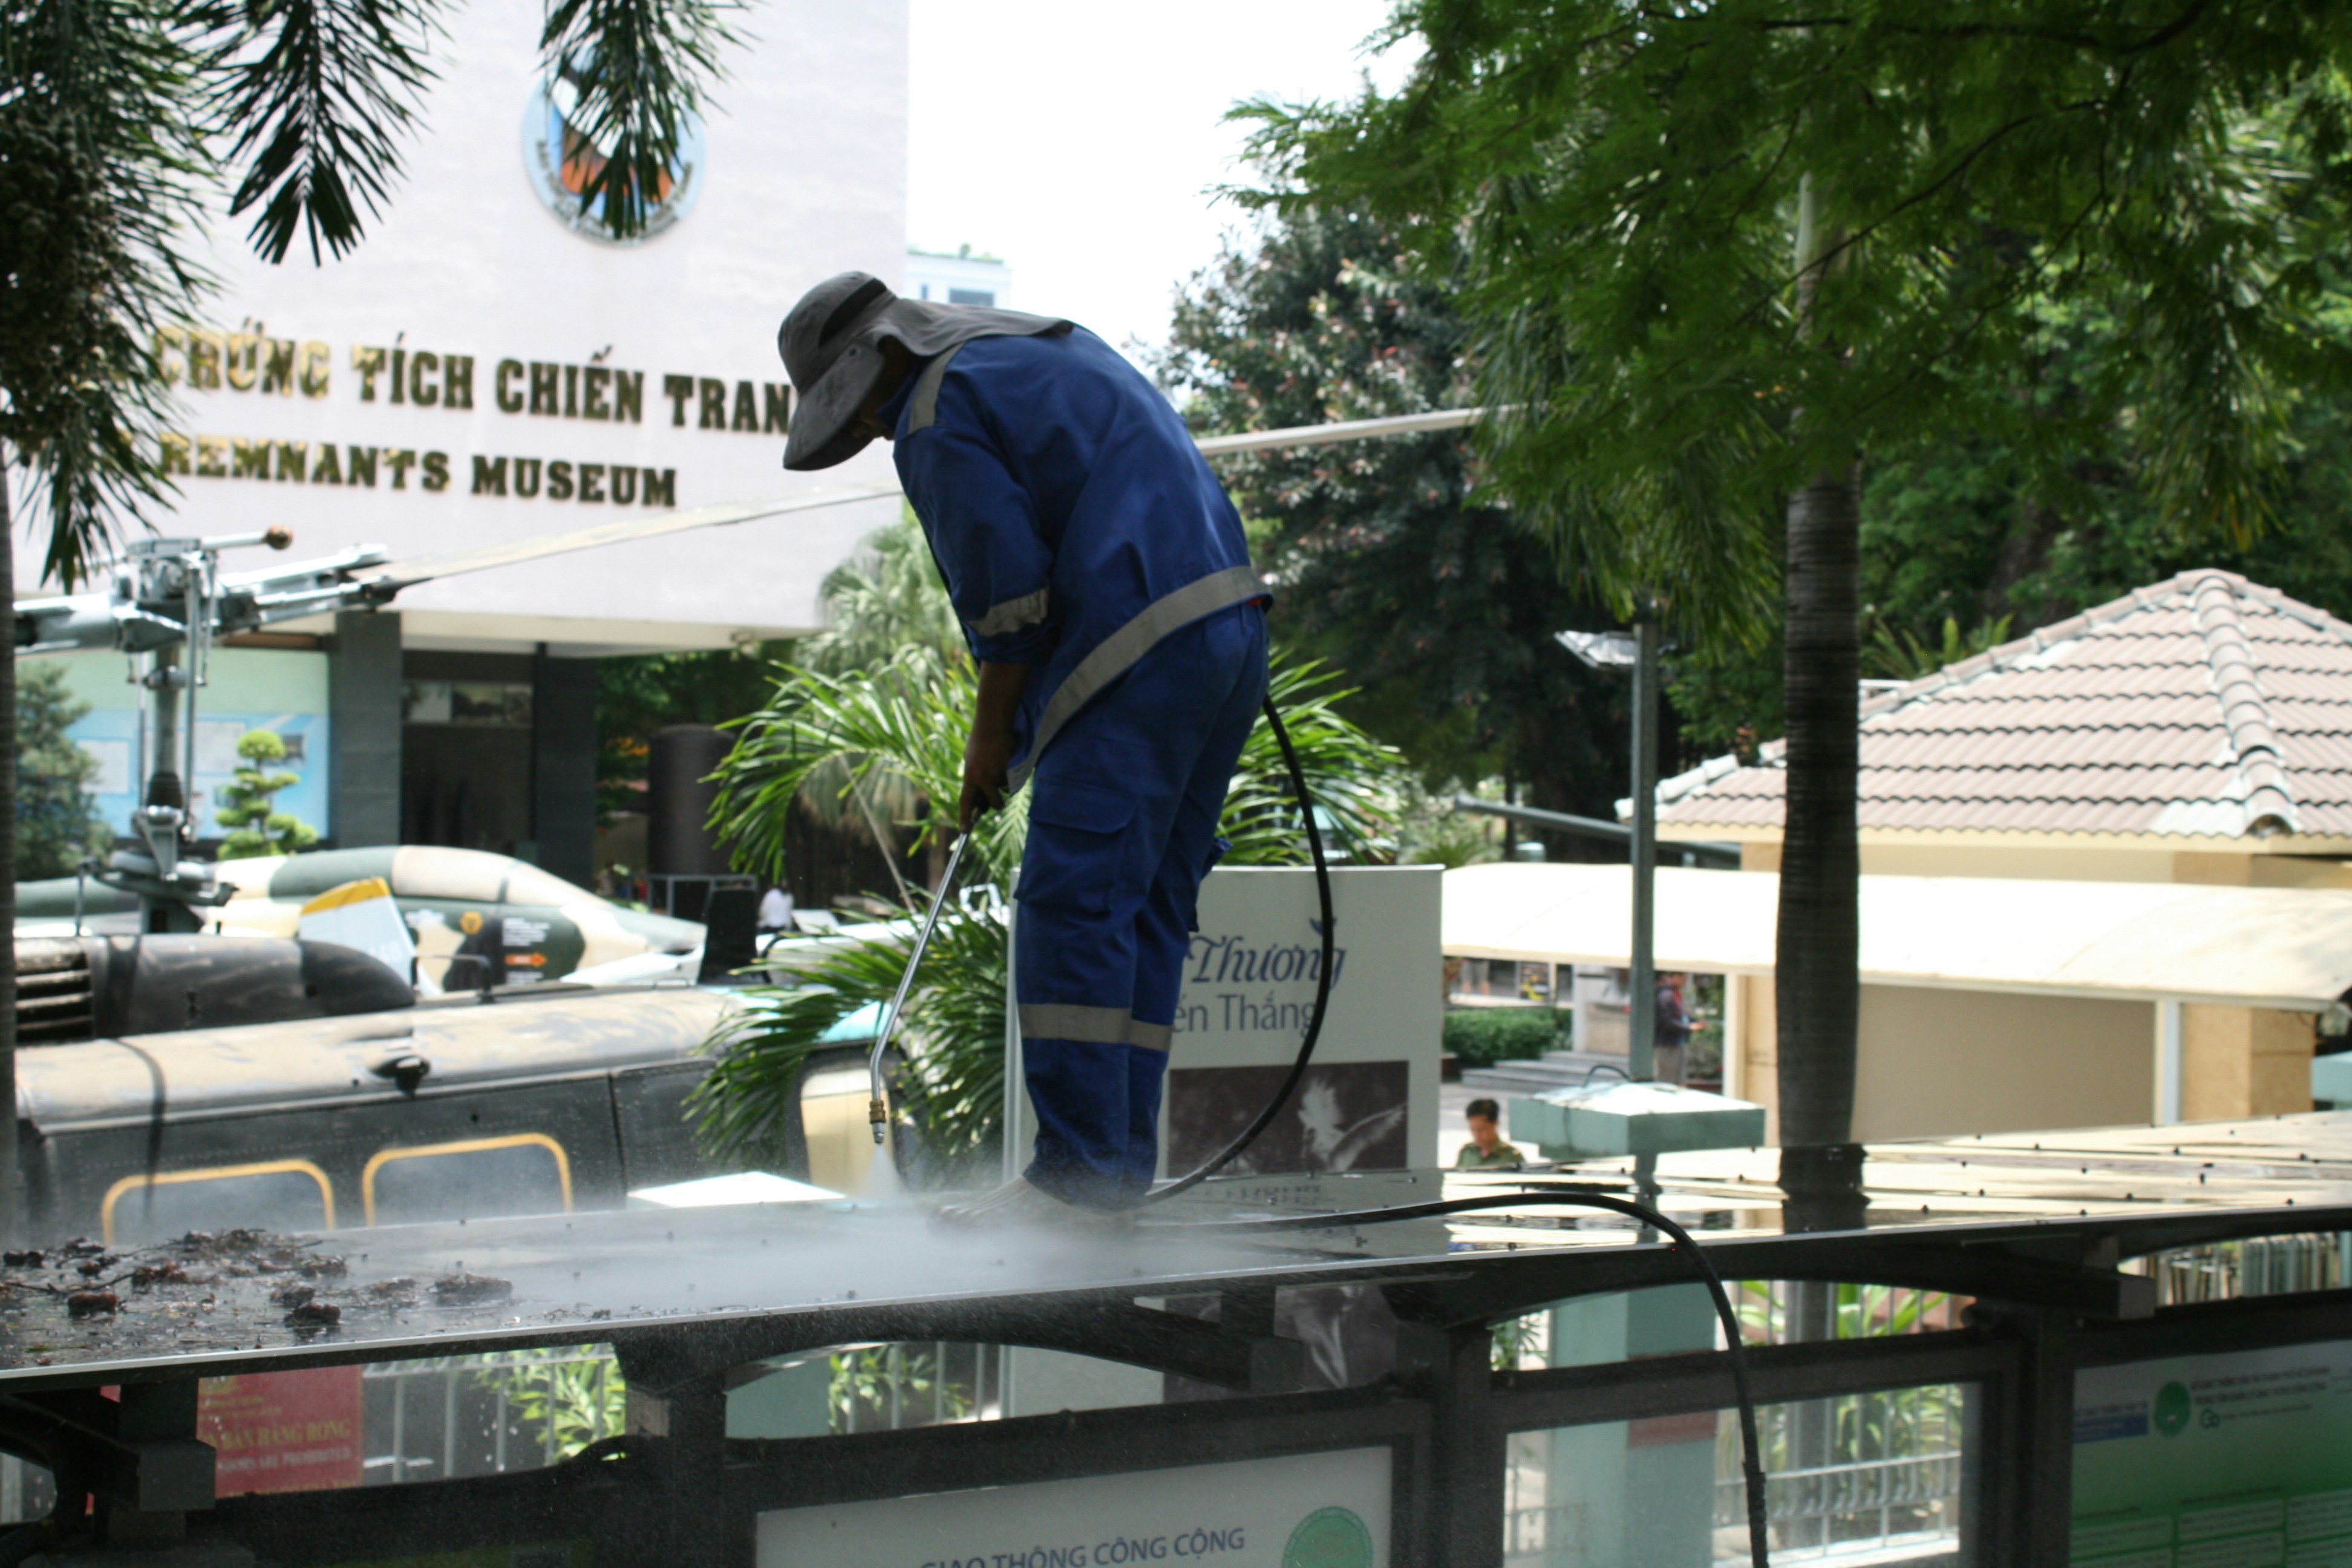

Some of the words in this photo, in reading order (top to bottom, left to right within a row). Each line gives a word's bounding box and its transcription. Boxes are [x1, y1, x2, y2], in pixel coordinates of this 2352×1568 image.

[351, 331, 475, 410] TÍCH
[495, 345, 644, 424] CHIẾN
[159, 431, 450, 492] REMNANTS
[471, 455, 677, 508] MUSEUM
[1093, 1537, 1168, 1566] CÔNG
[1174, 1527, 1245, 1559] CỘNG
